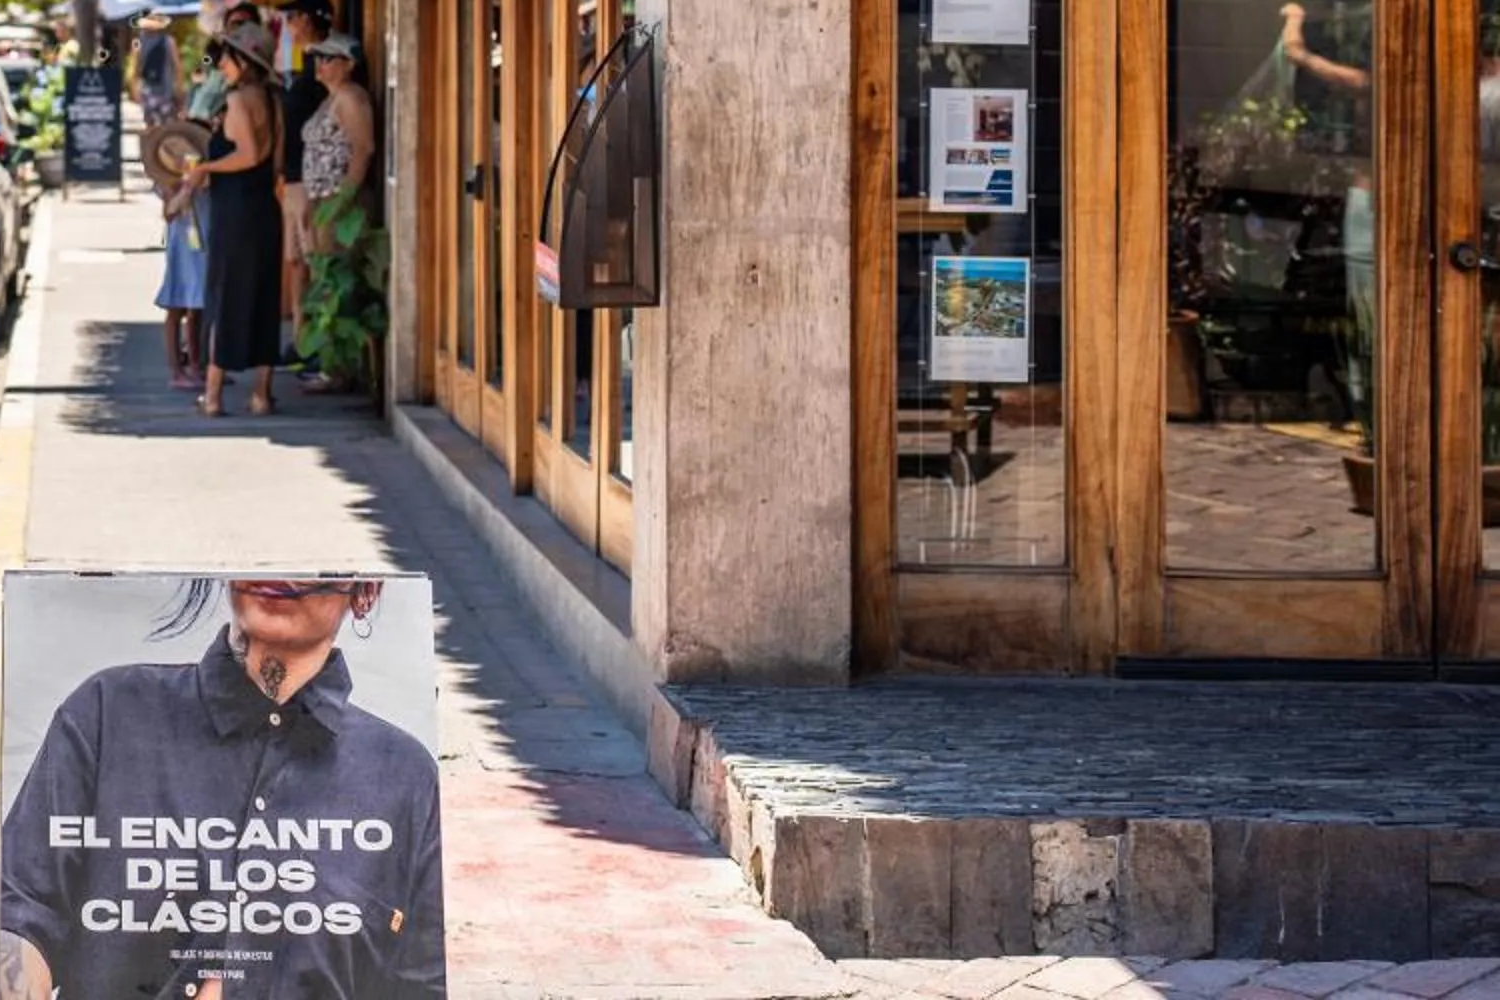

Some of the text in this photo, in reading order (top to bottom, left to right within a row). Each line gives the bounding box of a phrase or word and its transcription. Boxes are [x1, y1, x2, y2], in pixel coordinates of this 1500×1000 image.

[49, 816, 393, 851] EL ENCANTO
[126, 858, 316, 892] DE LOS
[81, 893, 363, 935] CLÁSICOS
